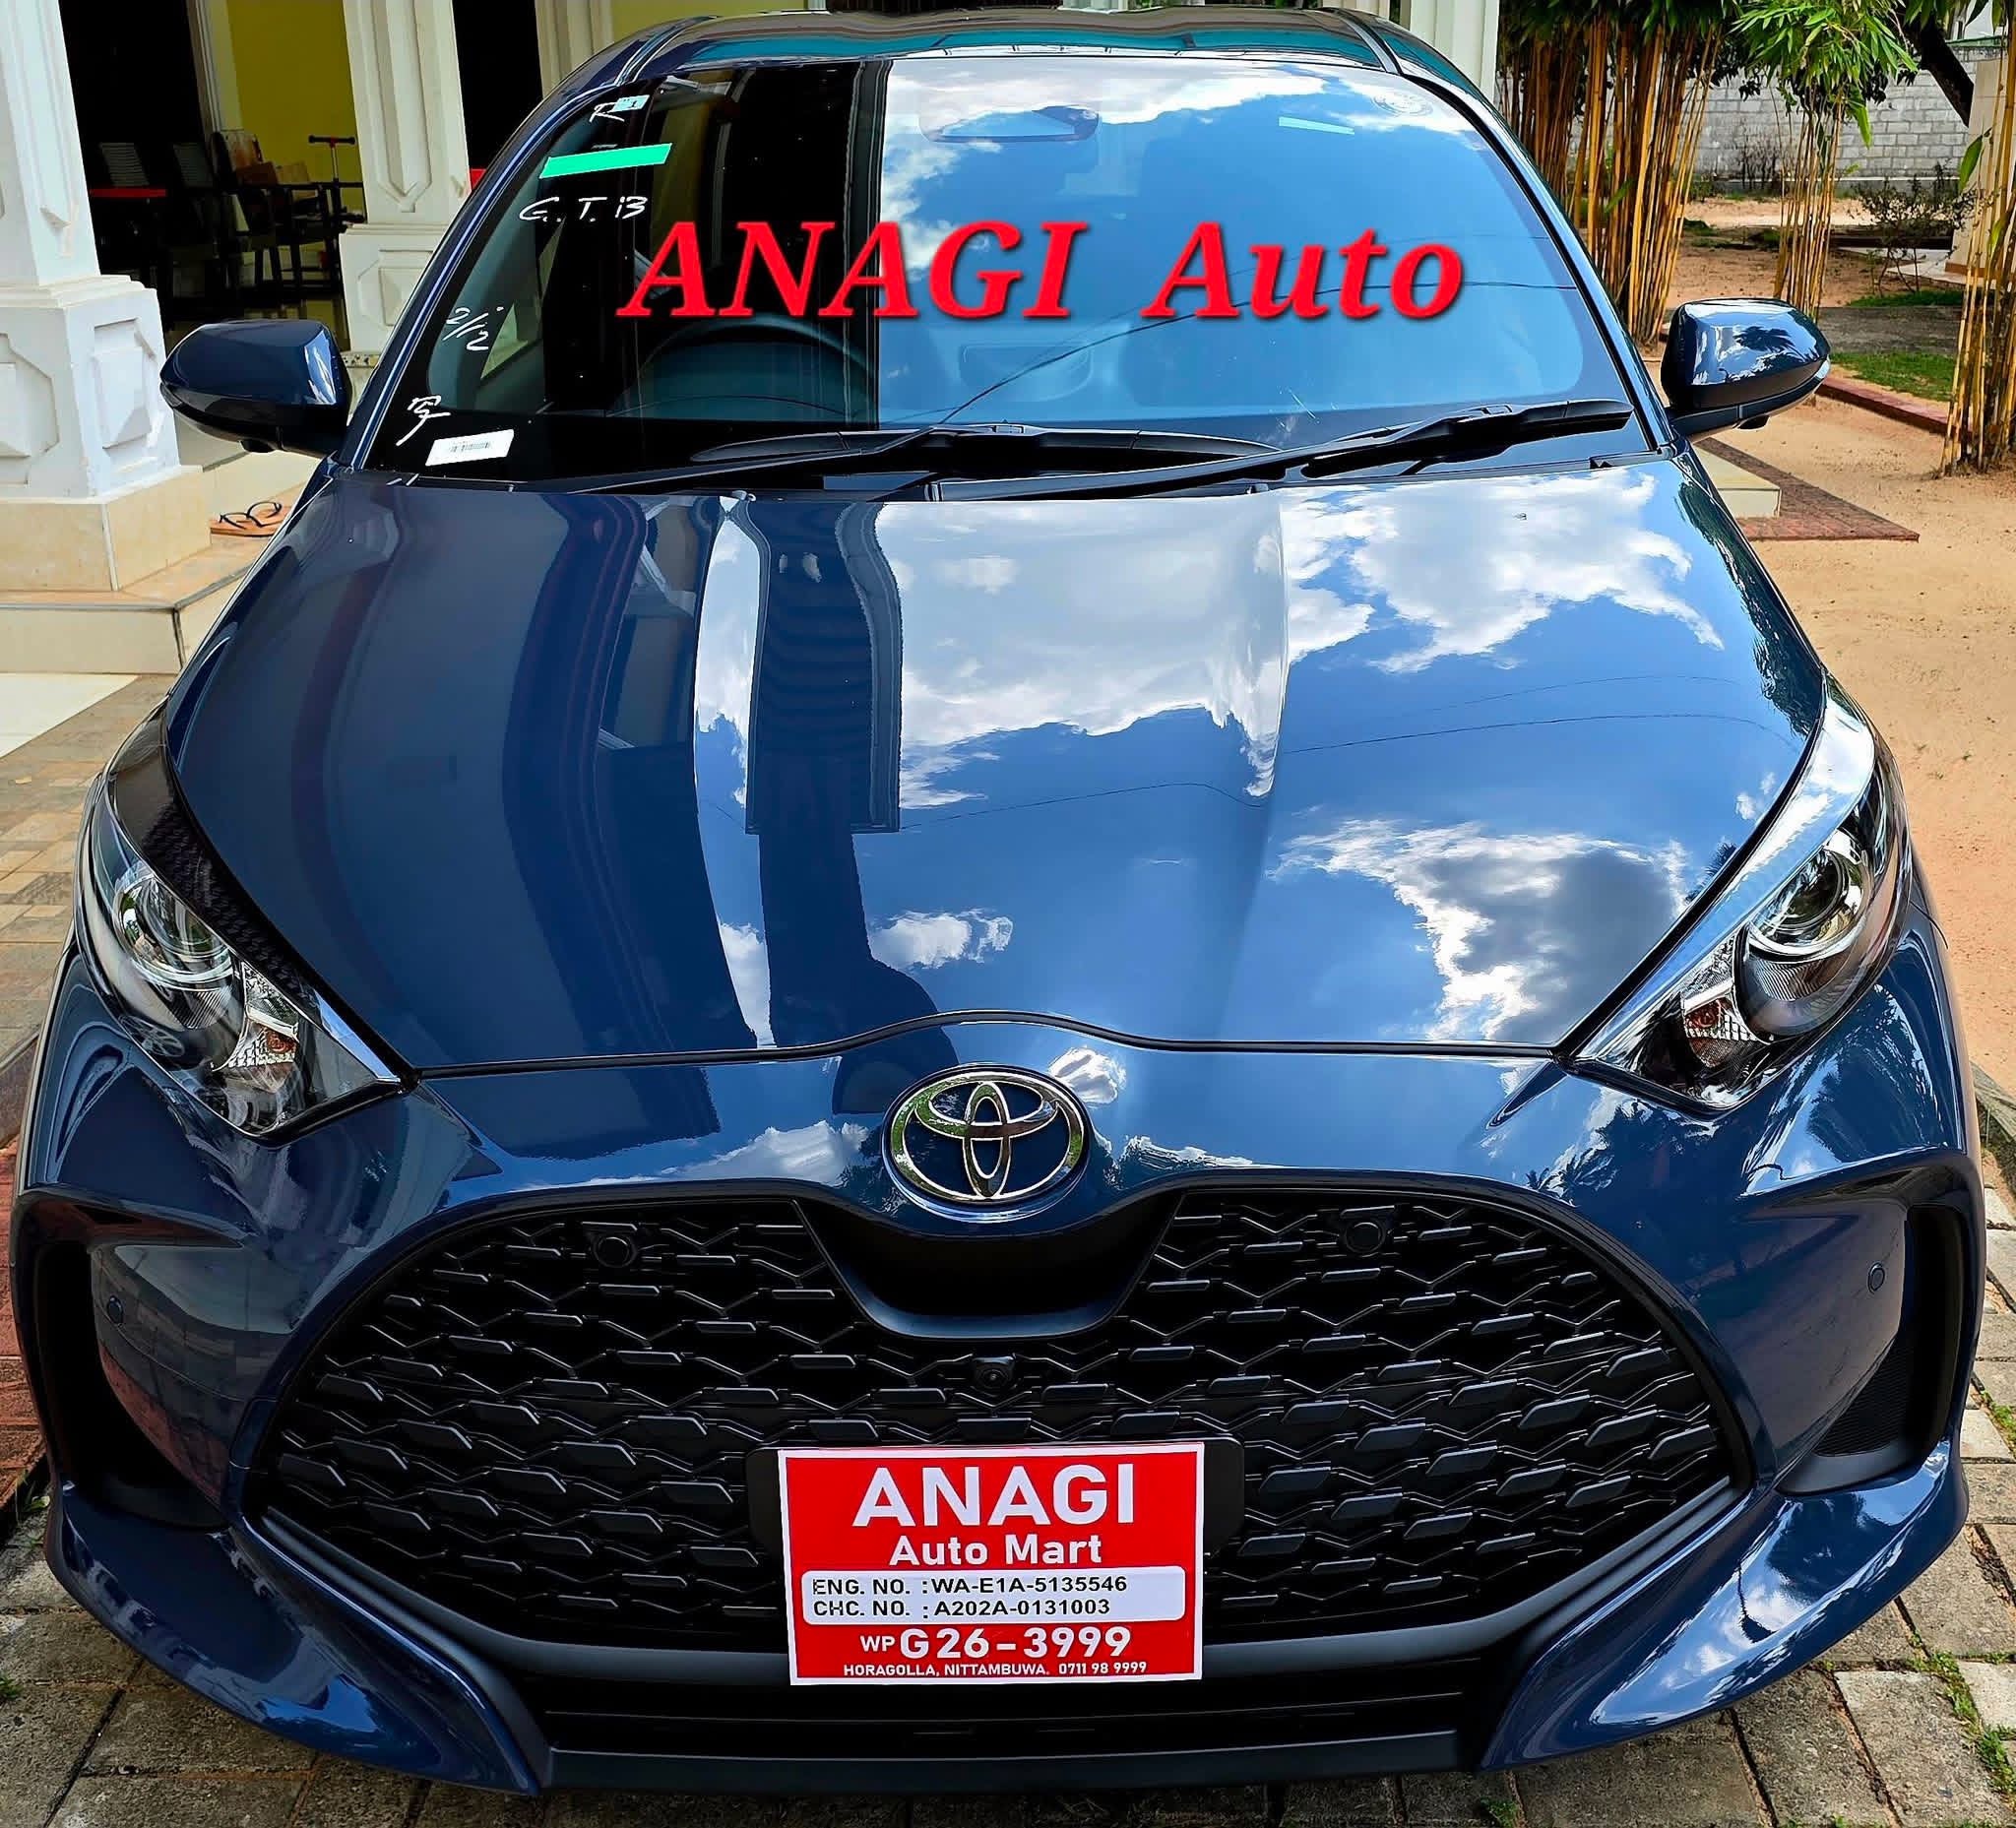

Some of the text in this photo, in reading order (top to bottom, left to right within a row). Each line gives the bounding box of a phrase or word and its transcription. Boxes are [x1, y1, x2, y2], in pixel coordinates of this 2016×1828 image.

[852, 1463, 1134, 1527] ANAGI
[890, 1534, 1102, 1566] Auto Mart
[813, 1579, 865, 1596] ENG.
[873, 1579, 911, 1595] NO.
[813, 1601, 865, 1617] CHC.
[873, 1601, 911, 1616] NO.
[859, 1635, 896, 1652] WP
[843, 1662, 1147, 1677] HORAGOLLA, NITTAMBUWA. 0711 98 9999
